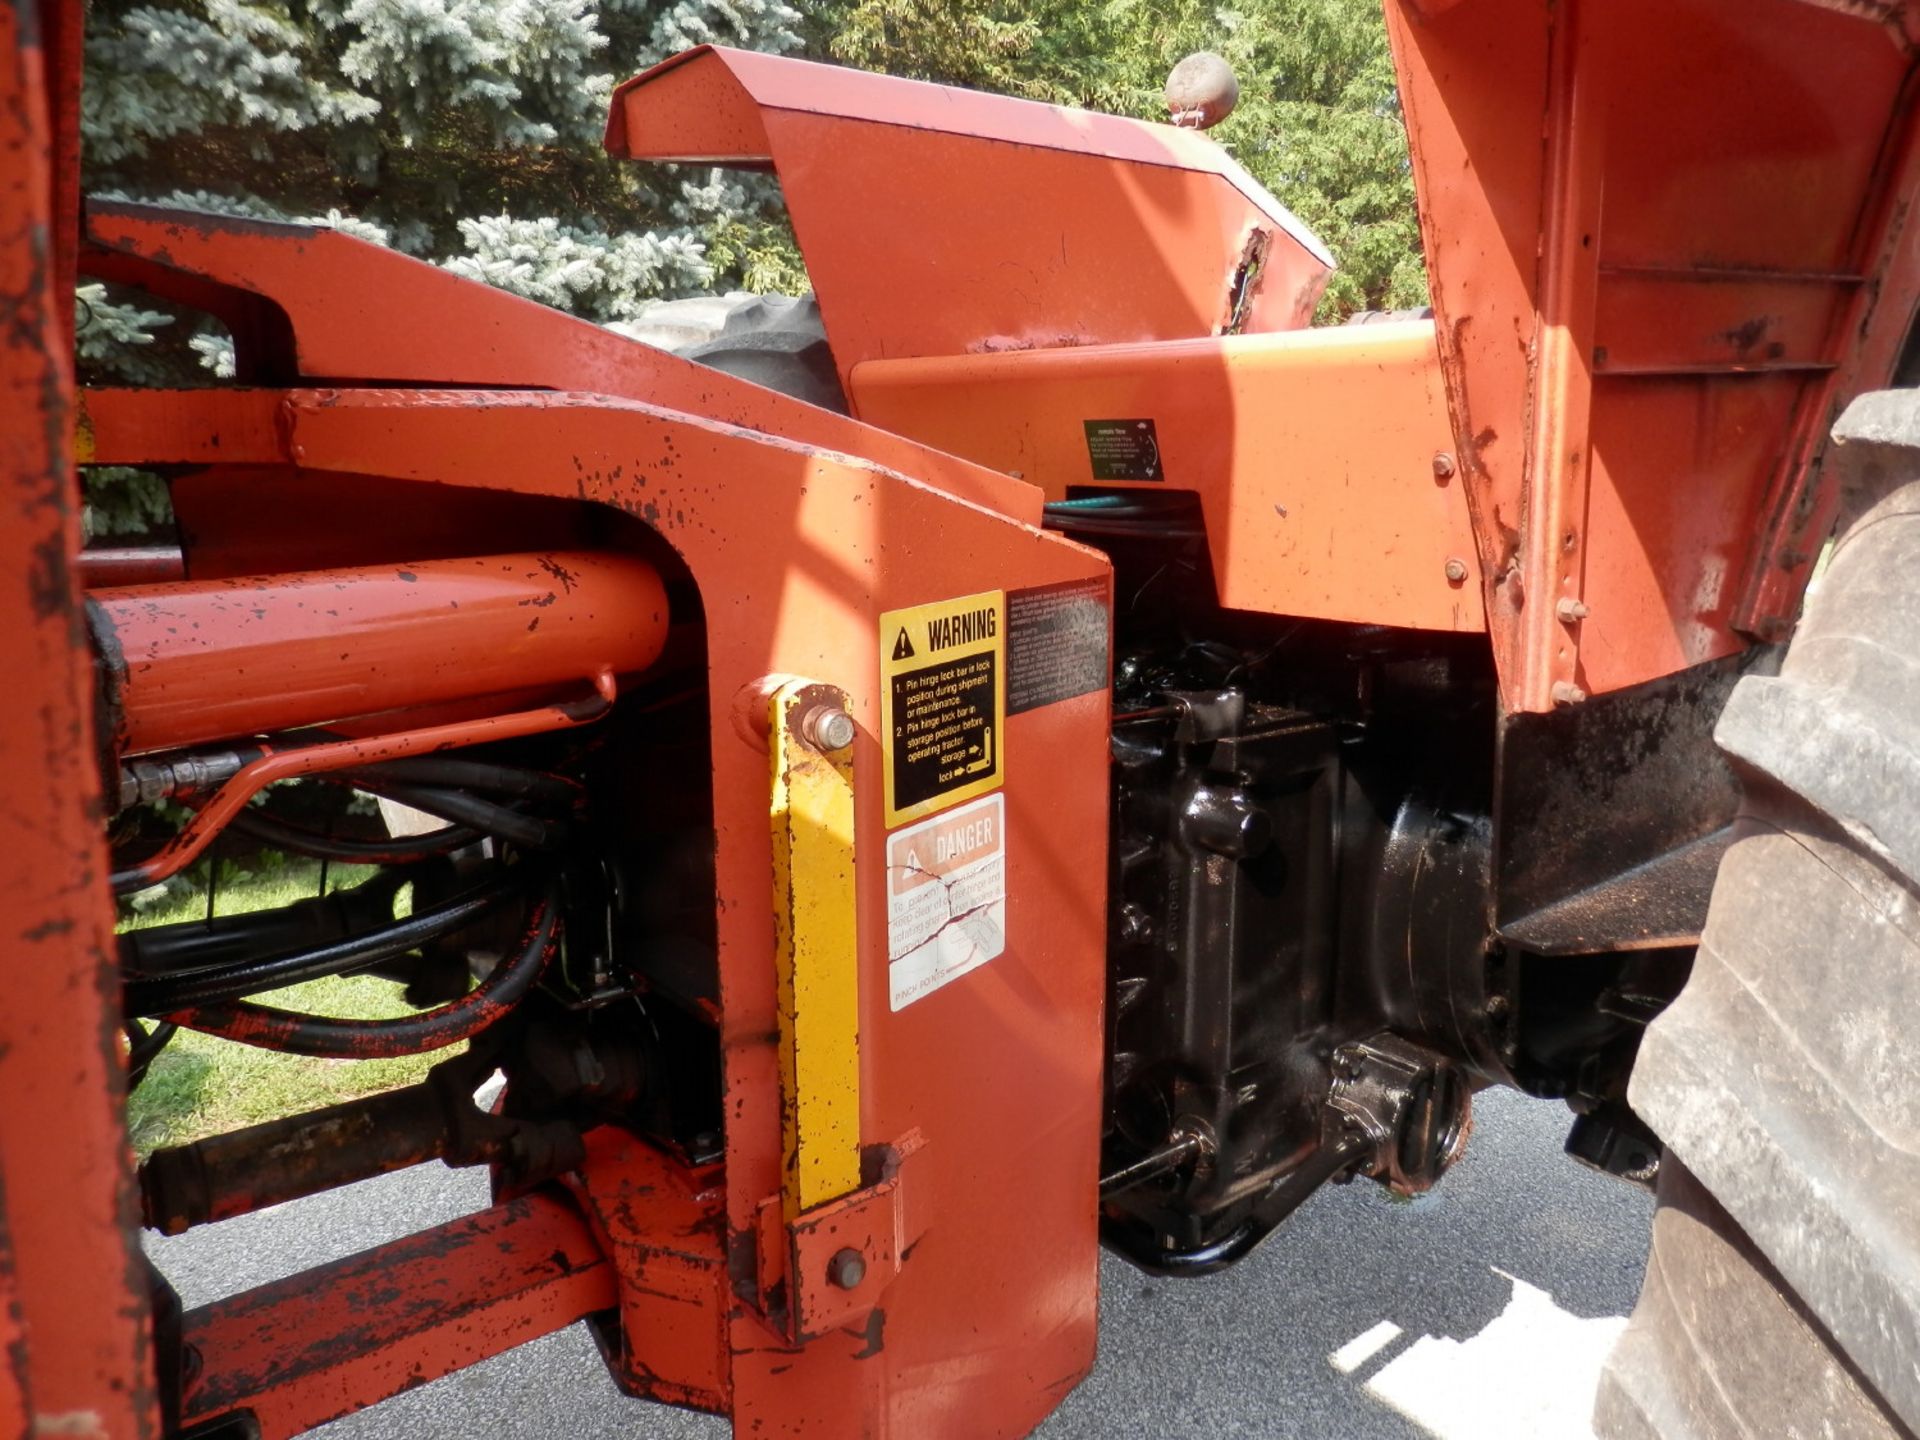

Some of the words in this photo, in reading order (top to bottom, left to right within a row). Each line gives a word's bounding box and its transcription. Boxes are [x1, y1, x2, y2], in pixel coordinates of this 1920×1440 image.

[928, 607, 996, 652] WARNING
[906, 680, 918, 690] Pin
[919, 675, 939, 687] hinge
[940, 670, 955, 681] lock
[956, 666, 968, 676] bar
[969, 664, 975, 673] in
[976, 660, 990, 671] lock
[907, 690, 934, 706] position
[935, 682, 957, 697] during
[959, 674, 988, 691] shipment
[907, 709, 915, 719] or
[907, 723, 918, 733] Pin
[920, 717, 939, 729] hinge
[941, 711, 955, 722] lock
[956, 708, 968, 718] bar
[969, 705, 976, 714] in
[907, 732, 934, 749] storage
[935, 725, 961, 741] position
[962, 717, 983, 730] before
[907, 744, 940, 763] operating
[941, 749, 966, 764] storage
[939, 771, 953, 783] lock
[937, 817, 993, 865] DANGER
[895, 985, 917, 1002] PINCH
[919, 968, 946, 990] POINTS
